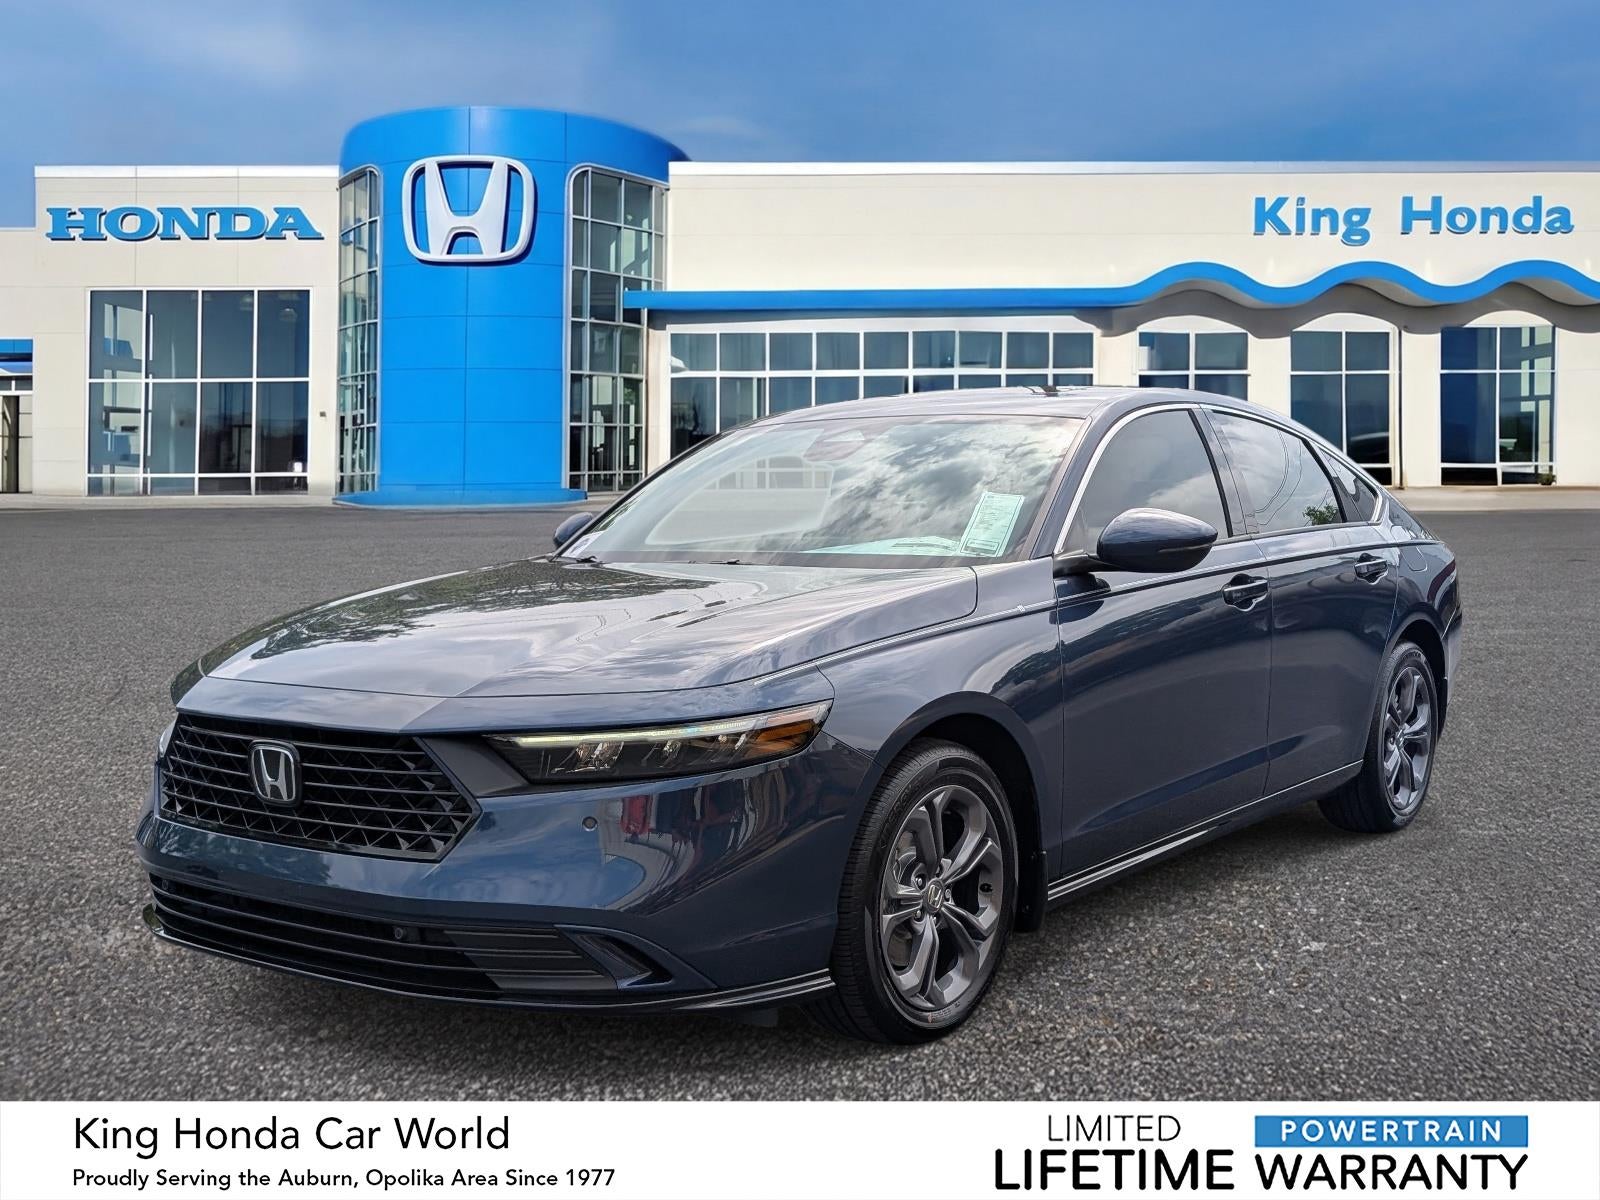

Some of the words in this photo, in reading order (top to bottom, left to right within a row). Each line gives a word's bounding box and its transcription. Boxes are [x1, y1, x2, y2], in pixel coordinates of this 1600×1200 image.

[46, 206, 325, 242] HONDA
[1253, 196, 1372, 247] King
[1401, 195, 1575, 235] Honda
